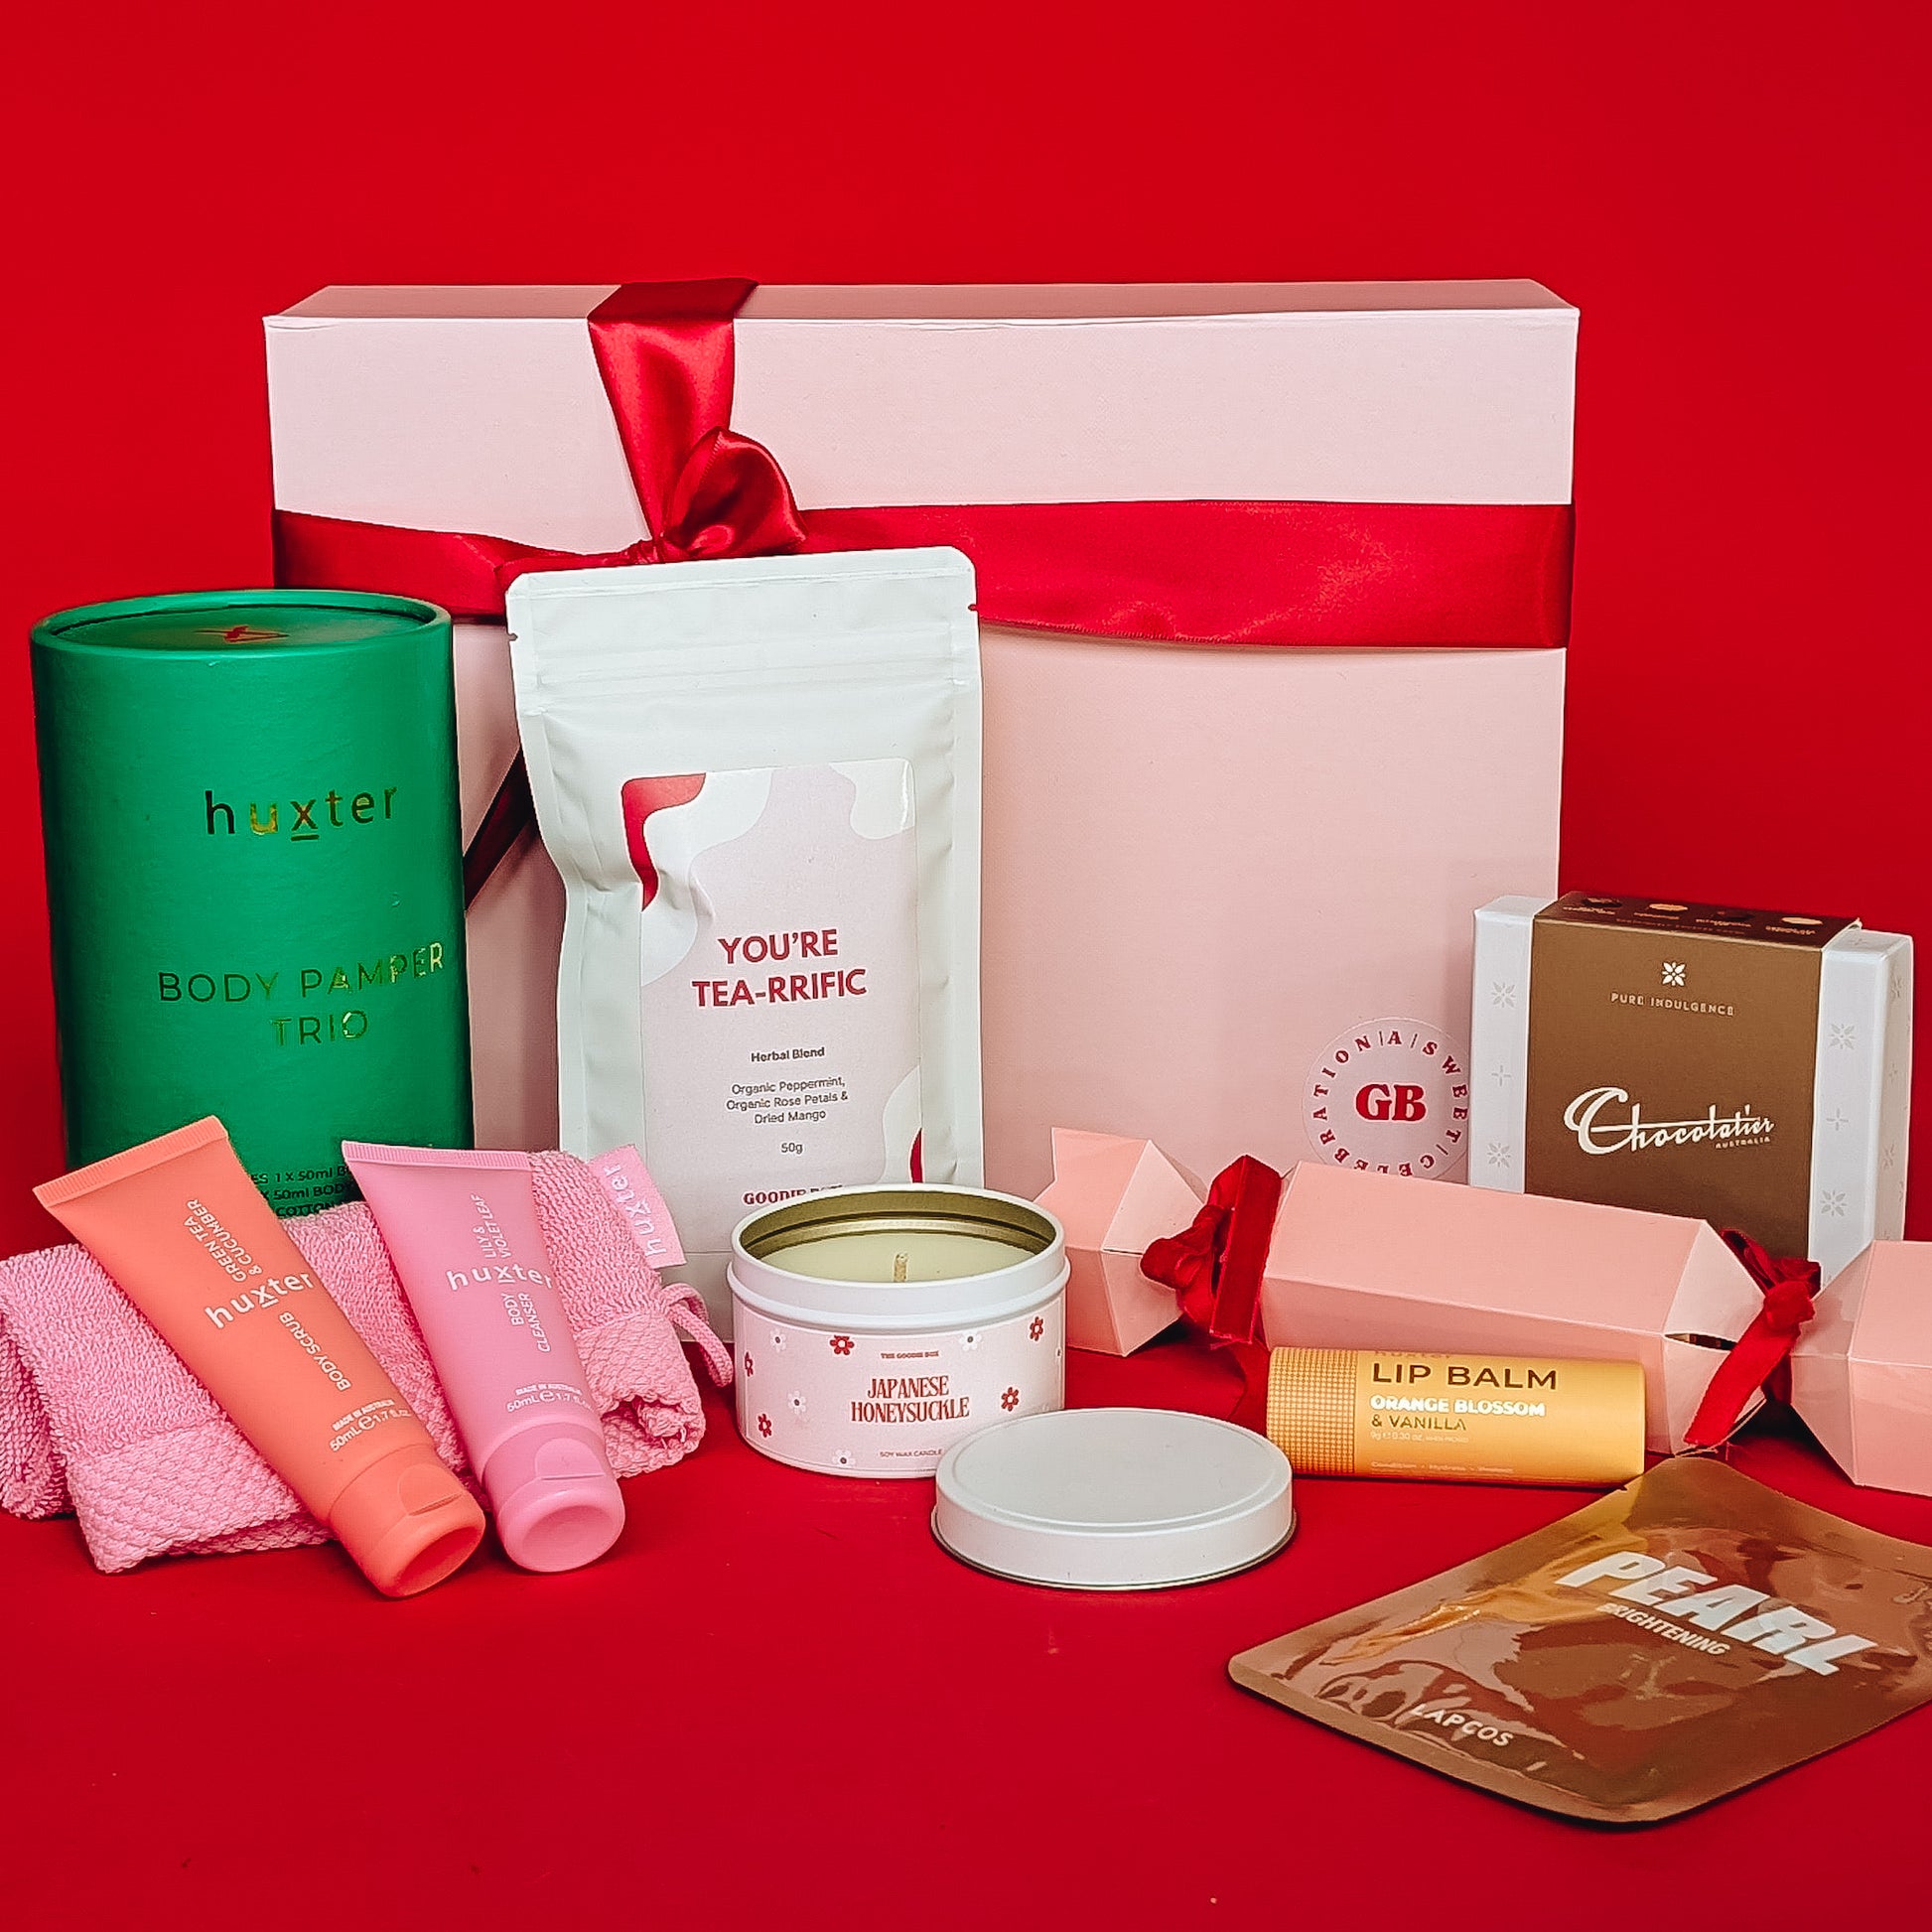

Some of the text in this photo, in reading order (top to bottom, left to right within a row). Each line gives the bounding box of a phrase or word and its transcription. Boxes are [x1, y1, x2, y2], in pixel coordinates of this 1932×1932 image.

[205, 787, 398, 841] huxter
[159, 942, 443, 1003] BODY PAMPER
[693, 969, 867, 1007] TEA-RRIFIC
[1610, 993, 1734, 1016] PURE INDULGENCE
[272, 1011, 367, 1044] TRIO
[1388, 1031, 1402, 1044] A
[751, 1046, 826, 1062] Herbal Blend
[726, 1090, 848, 1111] Organic Rose Petals &
[731, 1076, 846, 1096] Organic Peppermint,
[754, 1109, 827, 1124] Dried Mango
[1355, 1083, 1426, 1121] GB
[1563, 1086, 1775, 1156] Chocolatier
[780, 1142, 803, 1154] 50g
[1715, 1136, 1771, 1150] AUSTRALIA
[298, 1168, 333, 1181] 50ml
[273, 1187, 310, 1200] 50ml
[603, 1164, 667, 1257] huxter
[187, 1198, 262, 1276] & CUCUMBER
[470, 1193, 512, 1259] VIOLET LEAF
[184, 1215, 247, 1282] GREEN TEA
[477, 1235, 497, 1259] LILY
[446, 1263, 552, 1291] huxter
[204, 1273, 315, 1329] huxter
[500, 1293, 524, 1325] BODY
[517, 1293, 551, 1352] CLEANSER
[279, 1311, 352, 1392] BODY SCRUB
[867, 1375, 950, 1399] JAPANESE
[1372, 1362, 1557, 1391] LIP BALM
[851, 1396, 971, 1424] HONEYSUCKLE
[1370, 1394, 1546, 1418] ORANGE BLOSSOM
[1371, 1414, 1467, 1432] & VANILLA
[913, 1449, 942, 1457] CANDLE
[1555, 1551, 1878, 1676] PEARL
[1595, 1602, 1730, 1656] BRIGHTENING
[1410, 1703, 1514, 1747] LAPCOS
